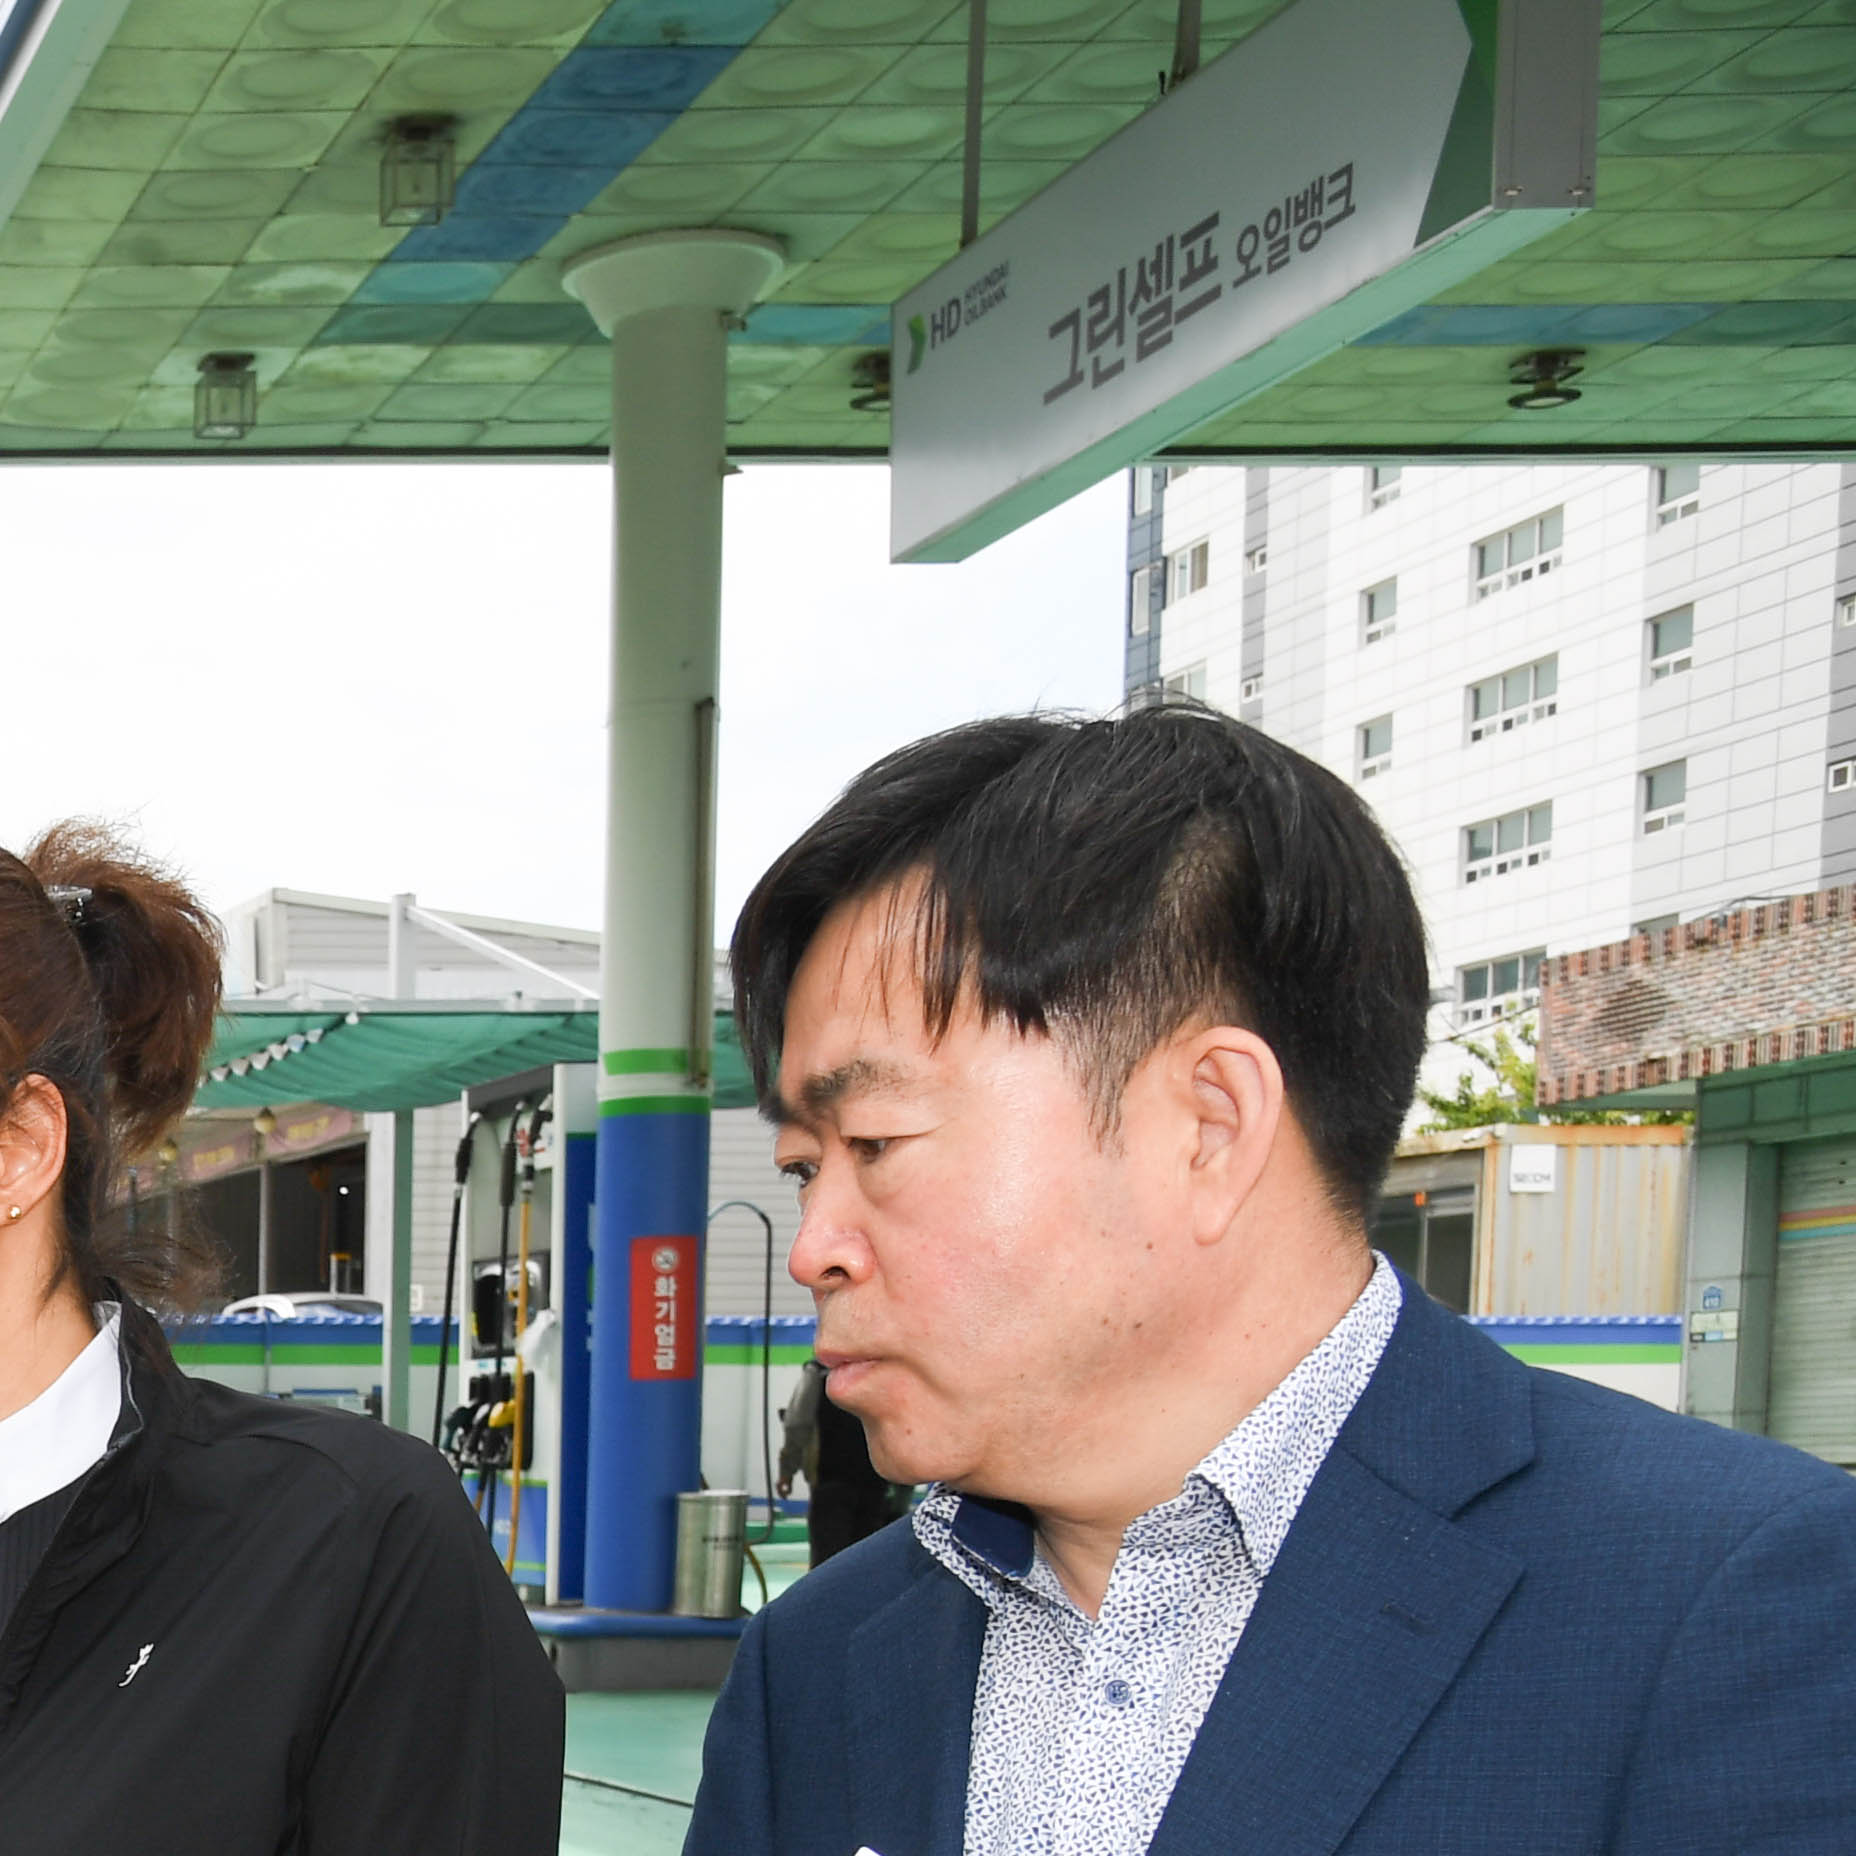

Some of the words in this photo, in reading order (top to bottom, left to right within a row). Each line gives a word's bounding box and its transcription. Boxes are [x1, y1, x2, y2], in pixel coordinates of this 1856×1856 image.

[931, 297, 962, 350] HD
[1044, 210, 1223, 406] 그린셀프
[1232, 161, 1356, 289] 오일뱅크
[654, 1275, 678, 1371] 화기엄금
